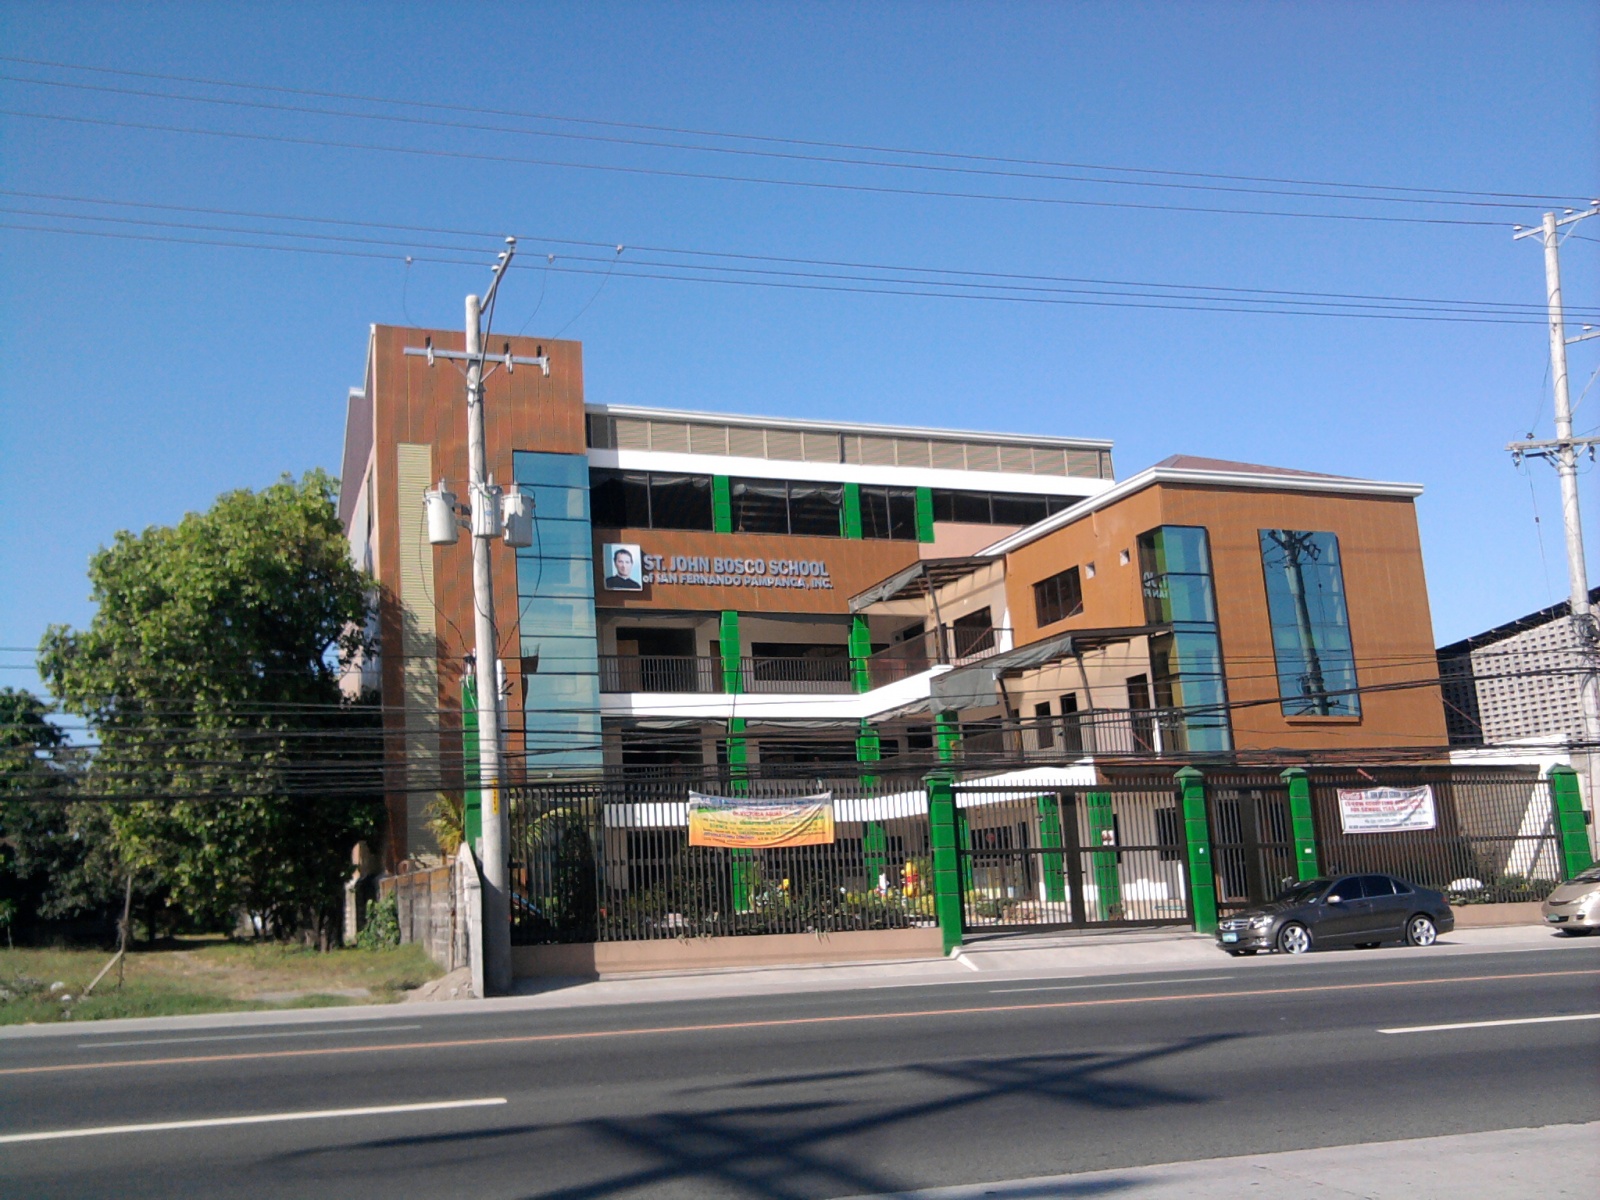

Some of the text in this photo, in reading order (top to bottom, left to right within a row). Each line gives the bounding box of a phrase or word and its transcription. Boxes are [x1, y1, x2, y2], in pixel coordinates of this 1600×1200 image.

[643, 554, 829, 576] ST. JOHN BOSCO SCHOOL
[642, 571, 653, 583] of
[680, 573, 742, 585] FERNANDO
[811, 578, 833, 588] INC.
